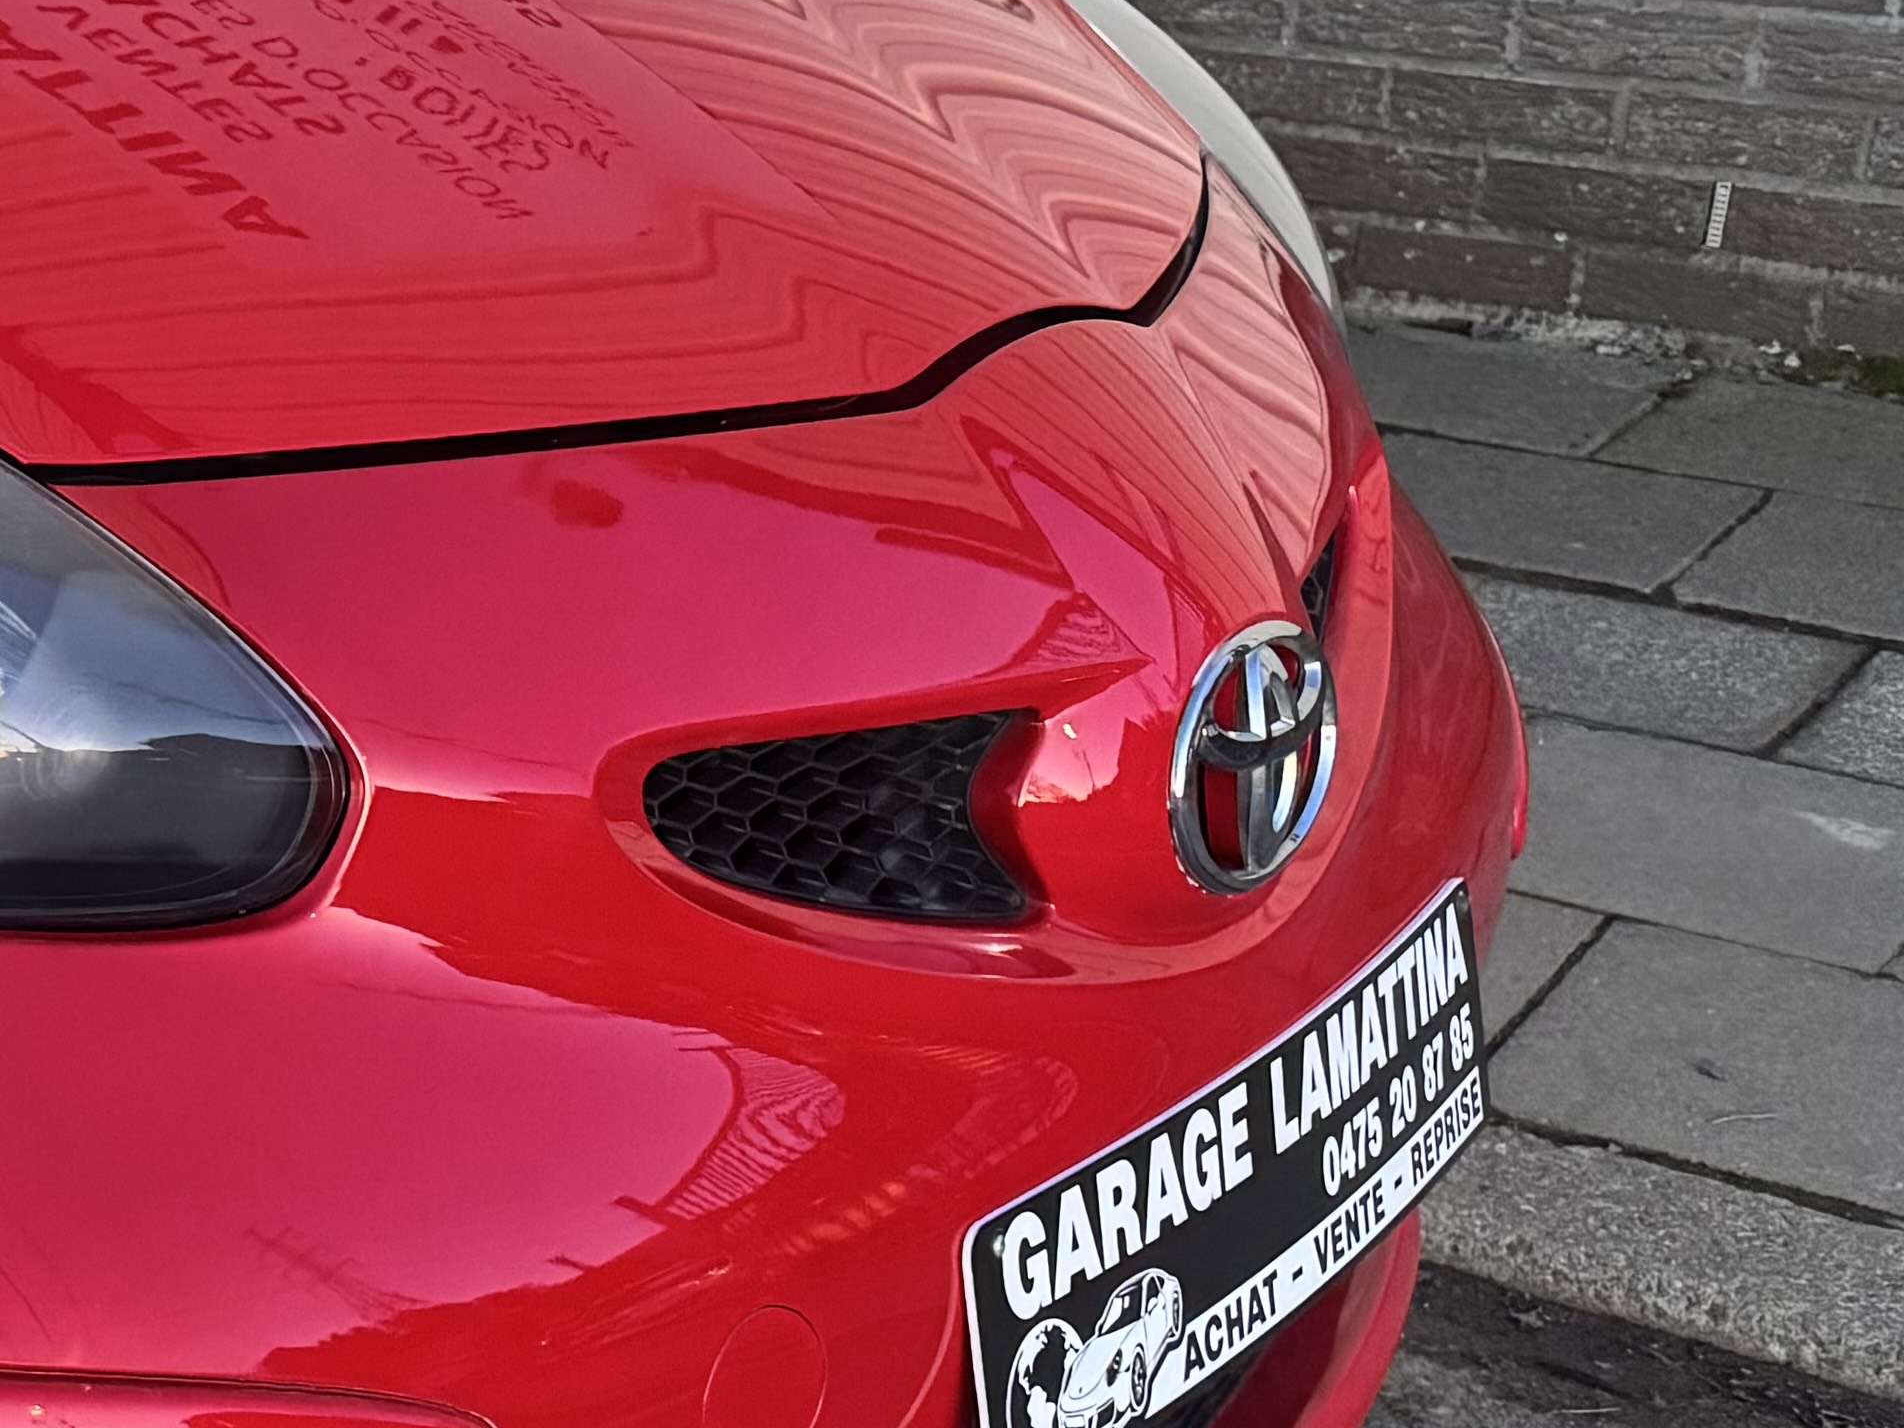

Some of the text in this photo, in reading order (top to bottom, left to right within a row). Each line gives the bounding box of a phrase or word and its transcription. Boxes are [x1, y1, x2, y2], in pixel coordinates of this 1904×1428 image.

[1000, 901, 1469, 1321] GARAGE LAMATTINA
[1183, 1268, 1280, 1380] ACHAT
[1312, 1177, 1386, 1274] VENTE
[1410, 1081, 1483, 1185] REPRISE
[1322, 1002, 1474, 1197] 0475 20 87 85
